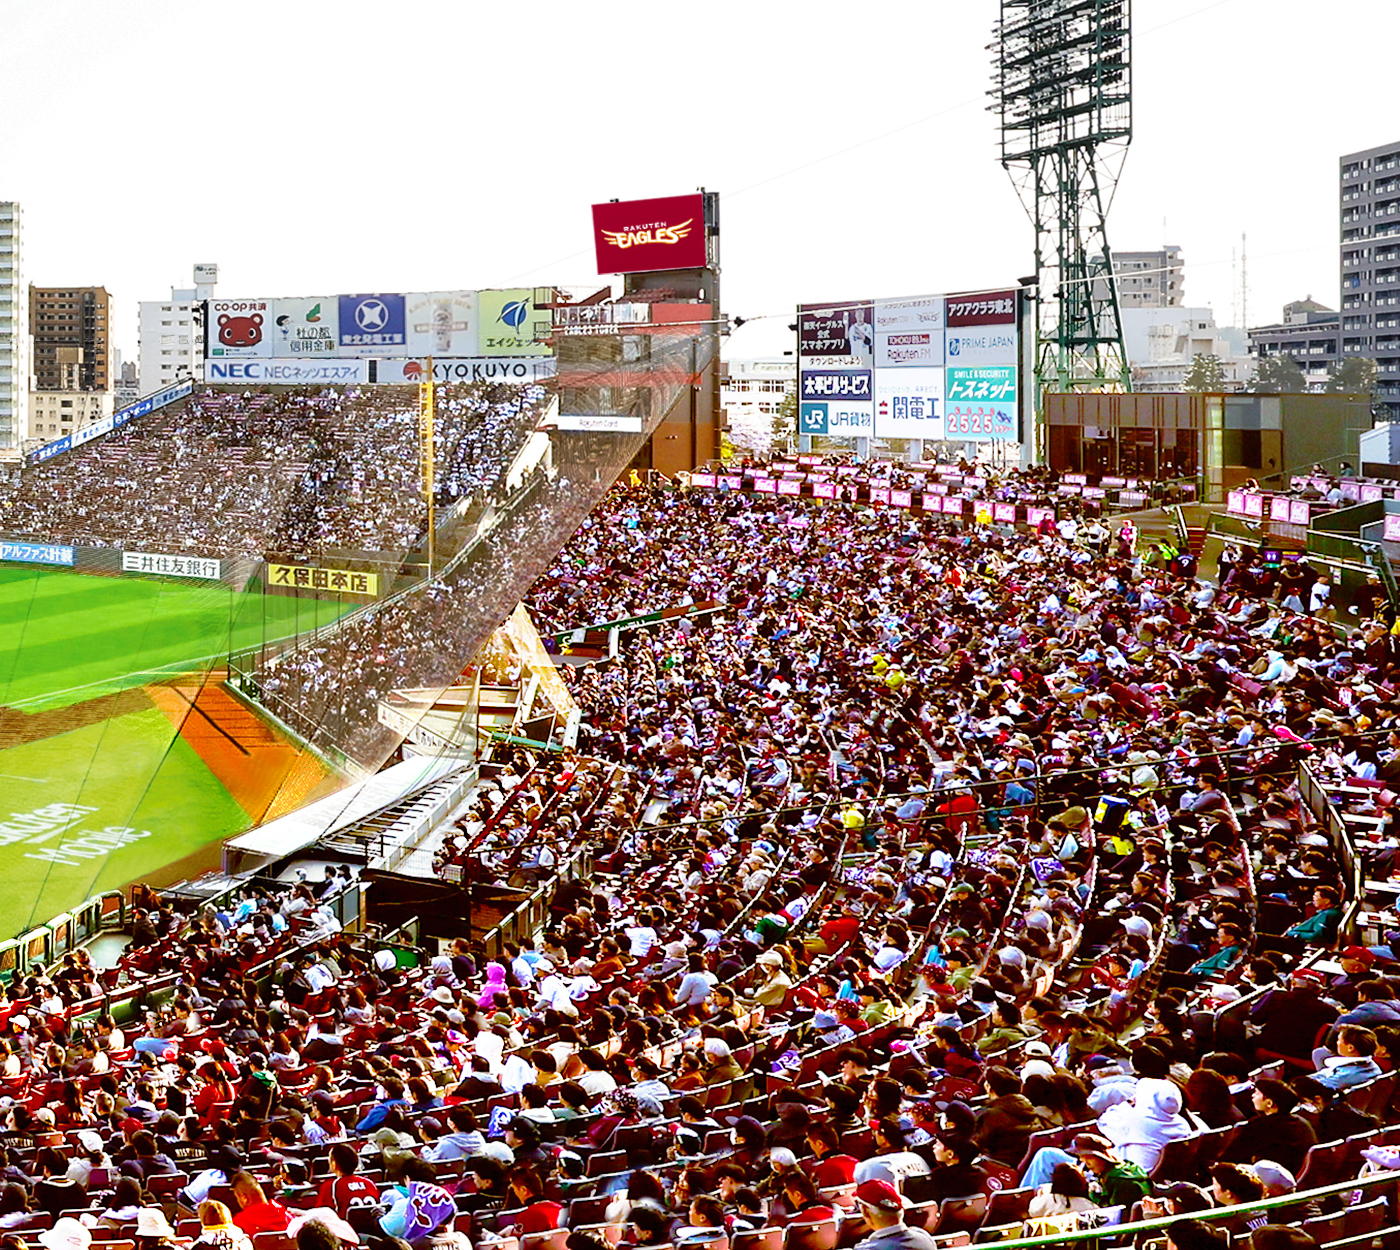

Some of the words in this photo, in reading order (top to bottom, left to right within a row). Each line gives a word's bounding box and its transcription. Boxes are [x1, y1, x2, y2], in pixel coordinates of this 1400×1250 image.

[623, 221, 667, 231] RAKUTEN
[611, 225, 684, 249] EAGLES
[948, 298, 1013, 316] アクアクララ東北
[290, 340, 335, 352] 信用金庫
[961, 337, 986, 348] PRIME
[988, 336, 1014, 348] JAPAN
[211, 363, 260, 379] NEC
[264, 366, 360, 380] NECネッツエスアイ
[979, 370, 1009, 378] SECURITY
[948, 380, 1015, 399] トスネット
[893, 396, 940, 419] 関電工
[805, 410, 824, 425] JR
[830, 412, 871, 426] JR貨物
[947, 412, 993, 433] 2525
[125, 554, 218, 578] 三井住友銀行
[273, 564, 368, 593] 久保田本店
